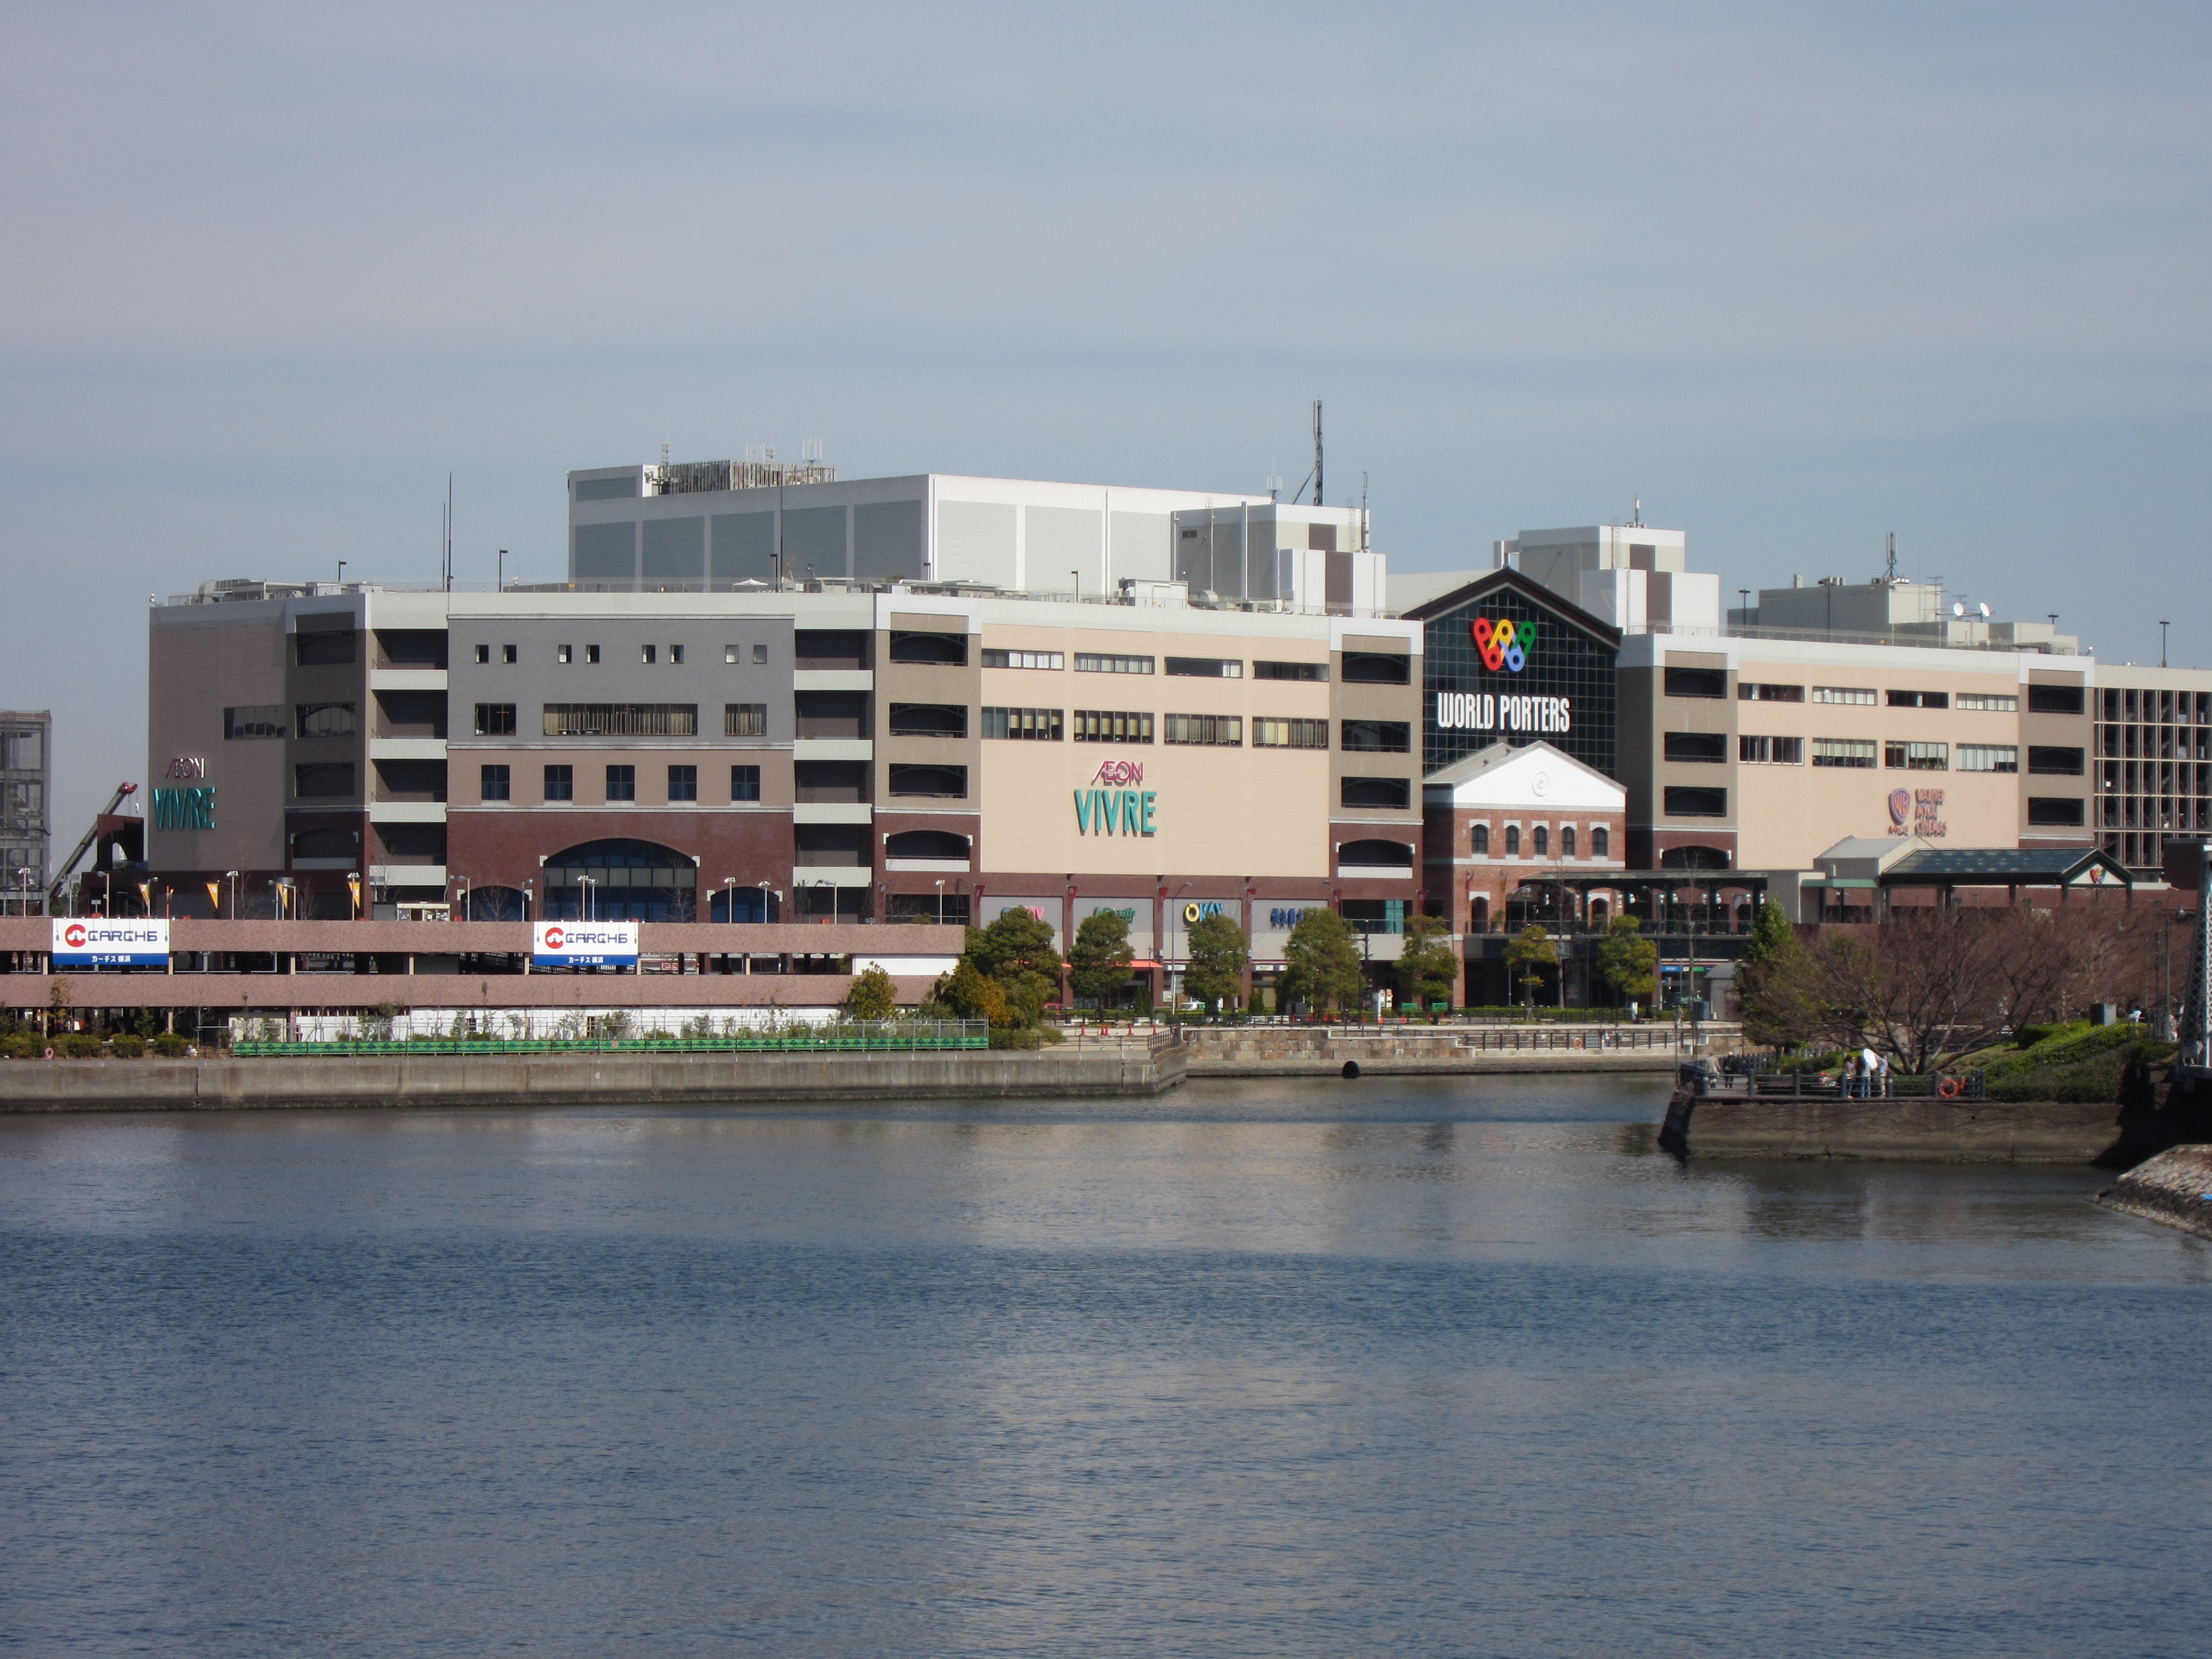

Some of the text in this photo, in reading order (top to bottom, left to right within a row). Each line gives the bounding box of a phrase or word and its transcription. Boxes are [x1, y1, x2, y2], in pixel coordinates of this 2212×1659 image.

[1437, 692, 1570, 733] WORLD PORTERS
[153, 787, 216, 830] VIVRE
[1074, 789, 1157, 832] VIVRE
